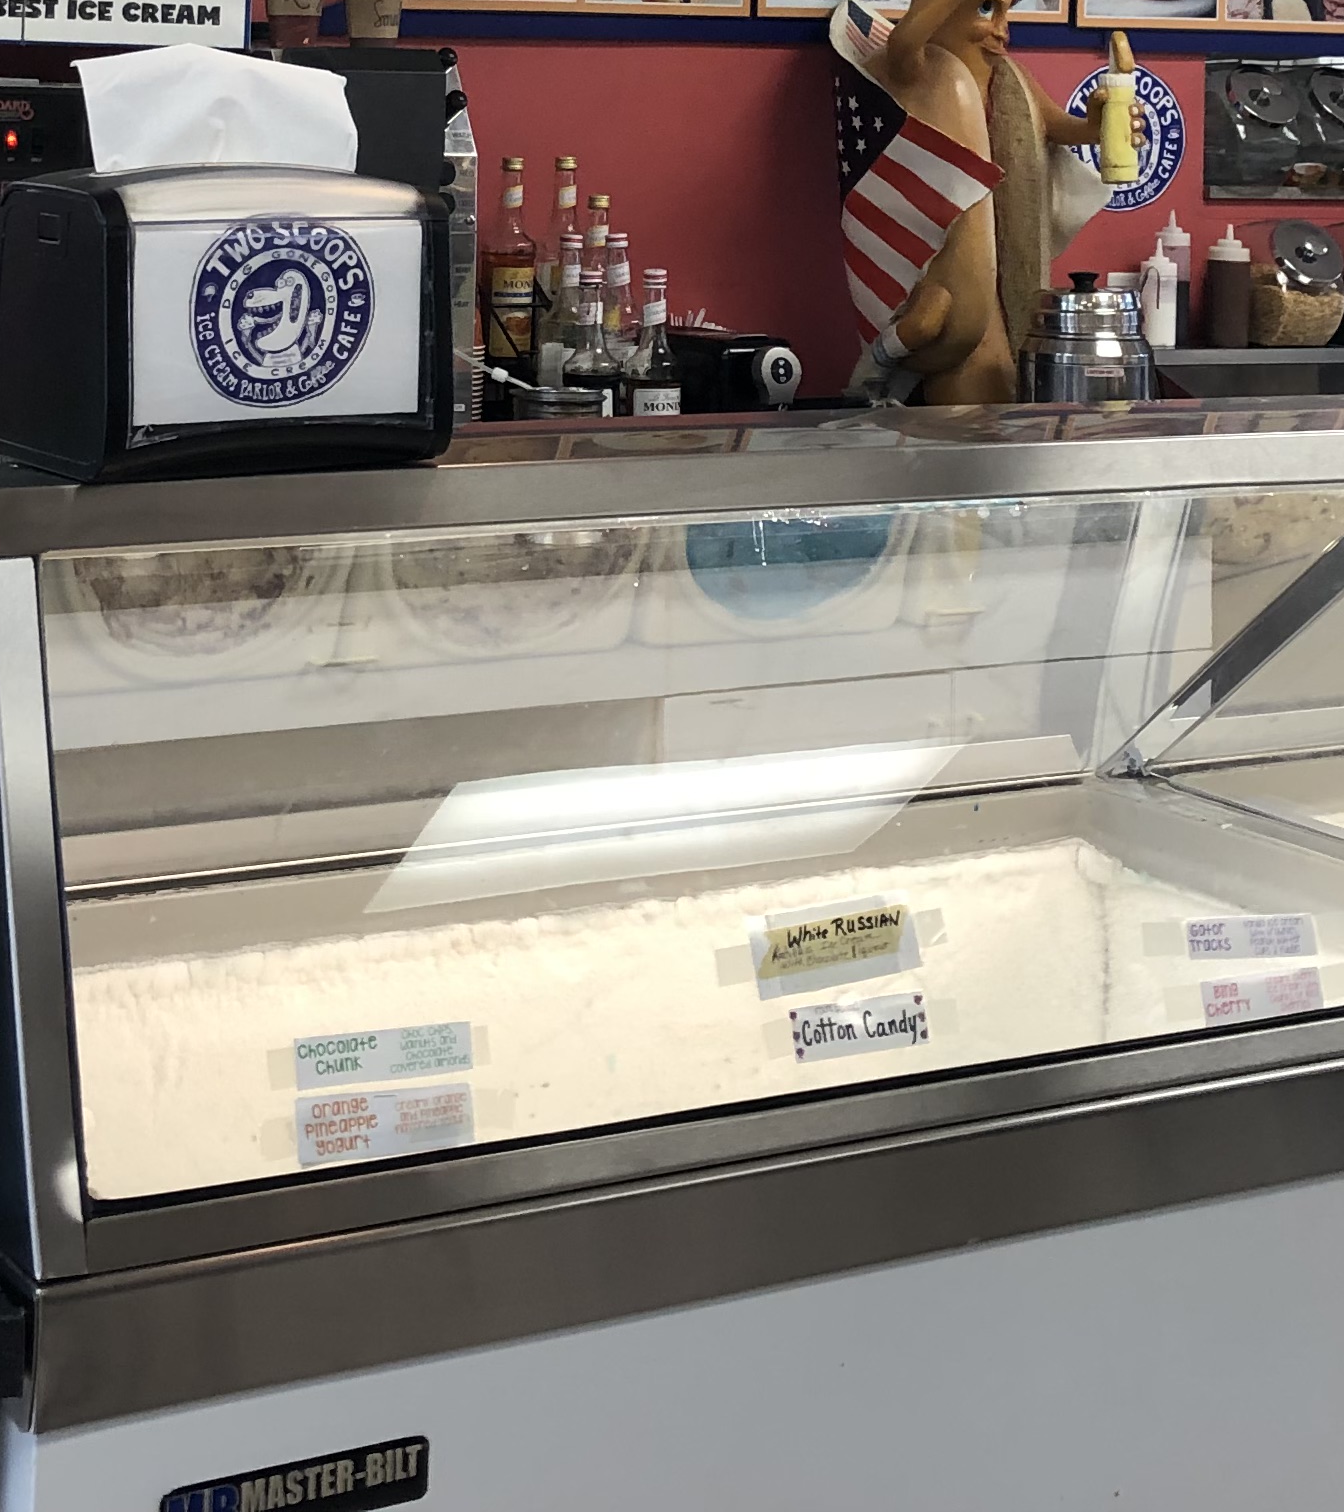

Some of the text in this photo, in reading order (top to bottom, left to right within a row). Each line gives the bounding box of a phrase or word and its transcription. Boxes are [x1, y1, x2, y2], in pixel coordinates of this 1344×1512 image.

[67, 0, 114, 21] ICE
[122, 2, 221, 26] CREAM
[1158, 142, 1178, 179] CAFE
[206, 221, 364, 291] TWO SCOOPS
[222, 263, 253, 309] DOG
[332, 310, 361, 360] CAFE
[831, 910, 901, 936] RUSSIAN
[801, 1009, 918, 1047] Cotton Candy
[240, 1444, 423, 1512] MASTER-BILT
